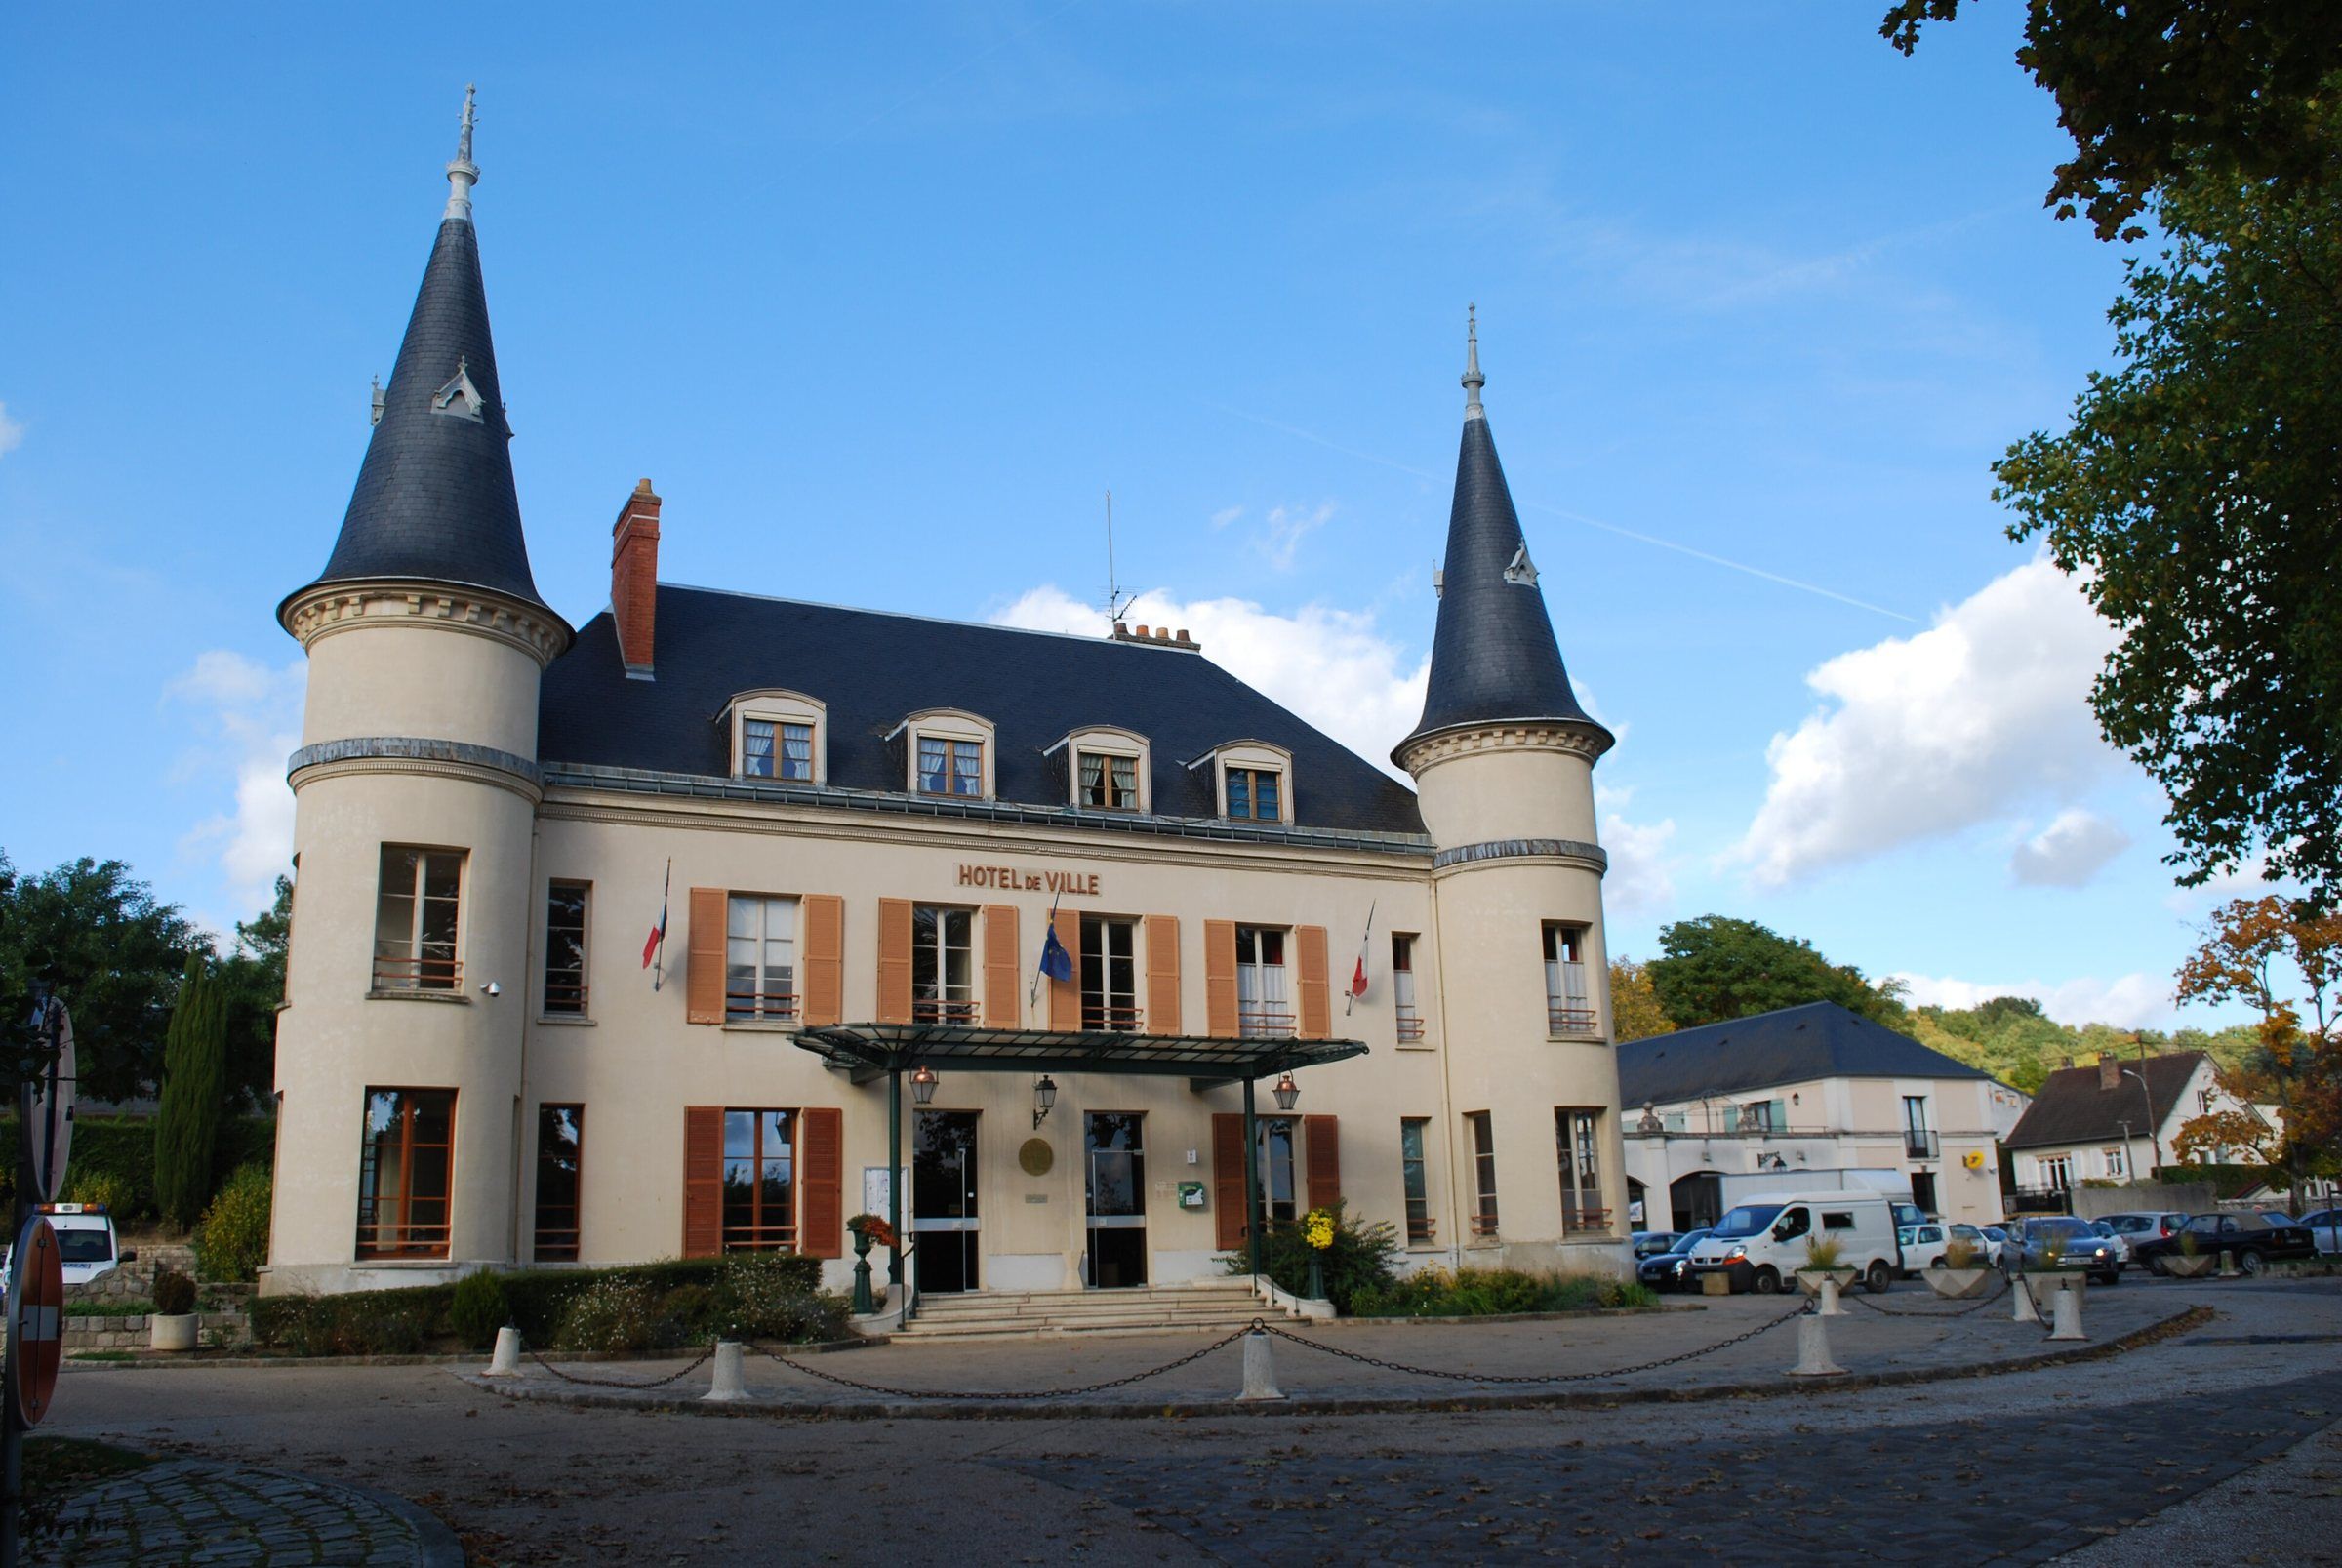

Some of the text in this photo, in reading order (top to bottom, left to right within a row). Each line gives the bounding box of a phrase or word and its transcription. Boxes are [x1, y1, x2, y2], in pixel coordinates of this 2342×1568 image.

[959, 864, 1099, 895] HOTEL DE VILLE
